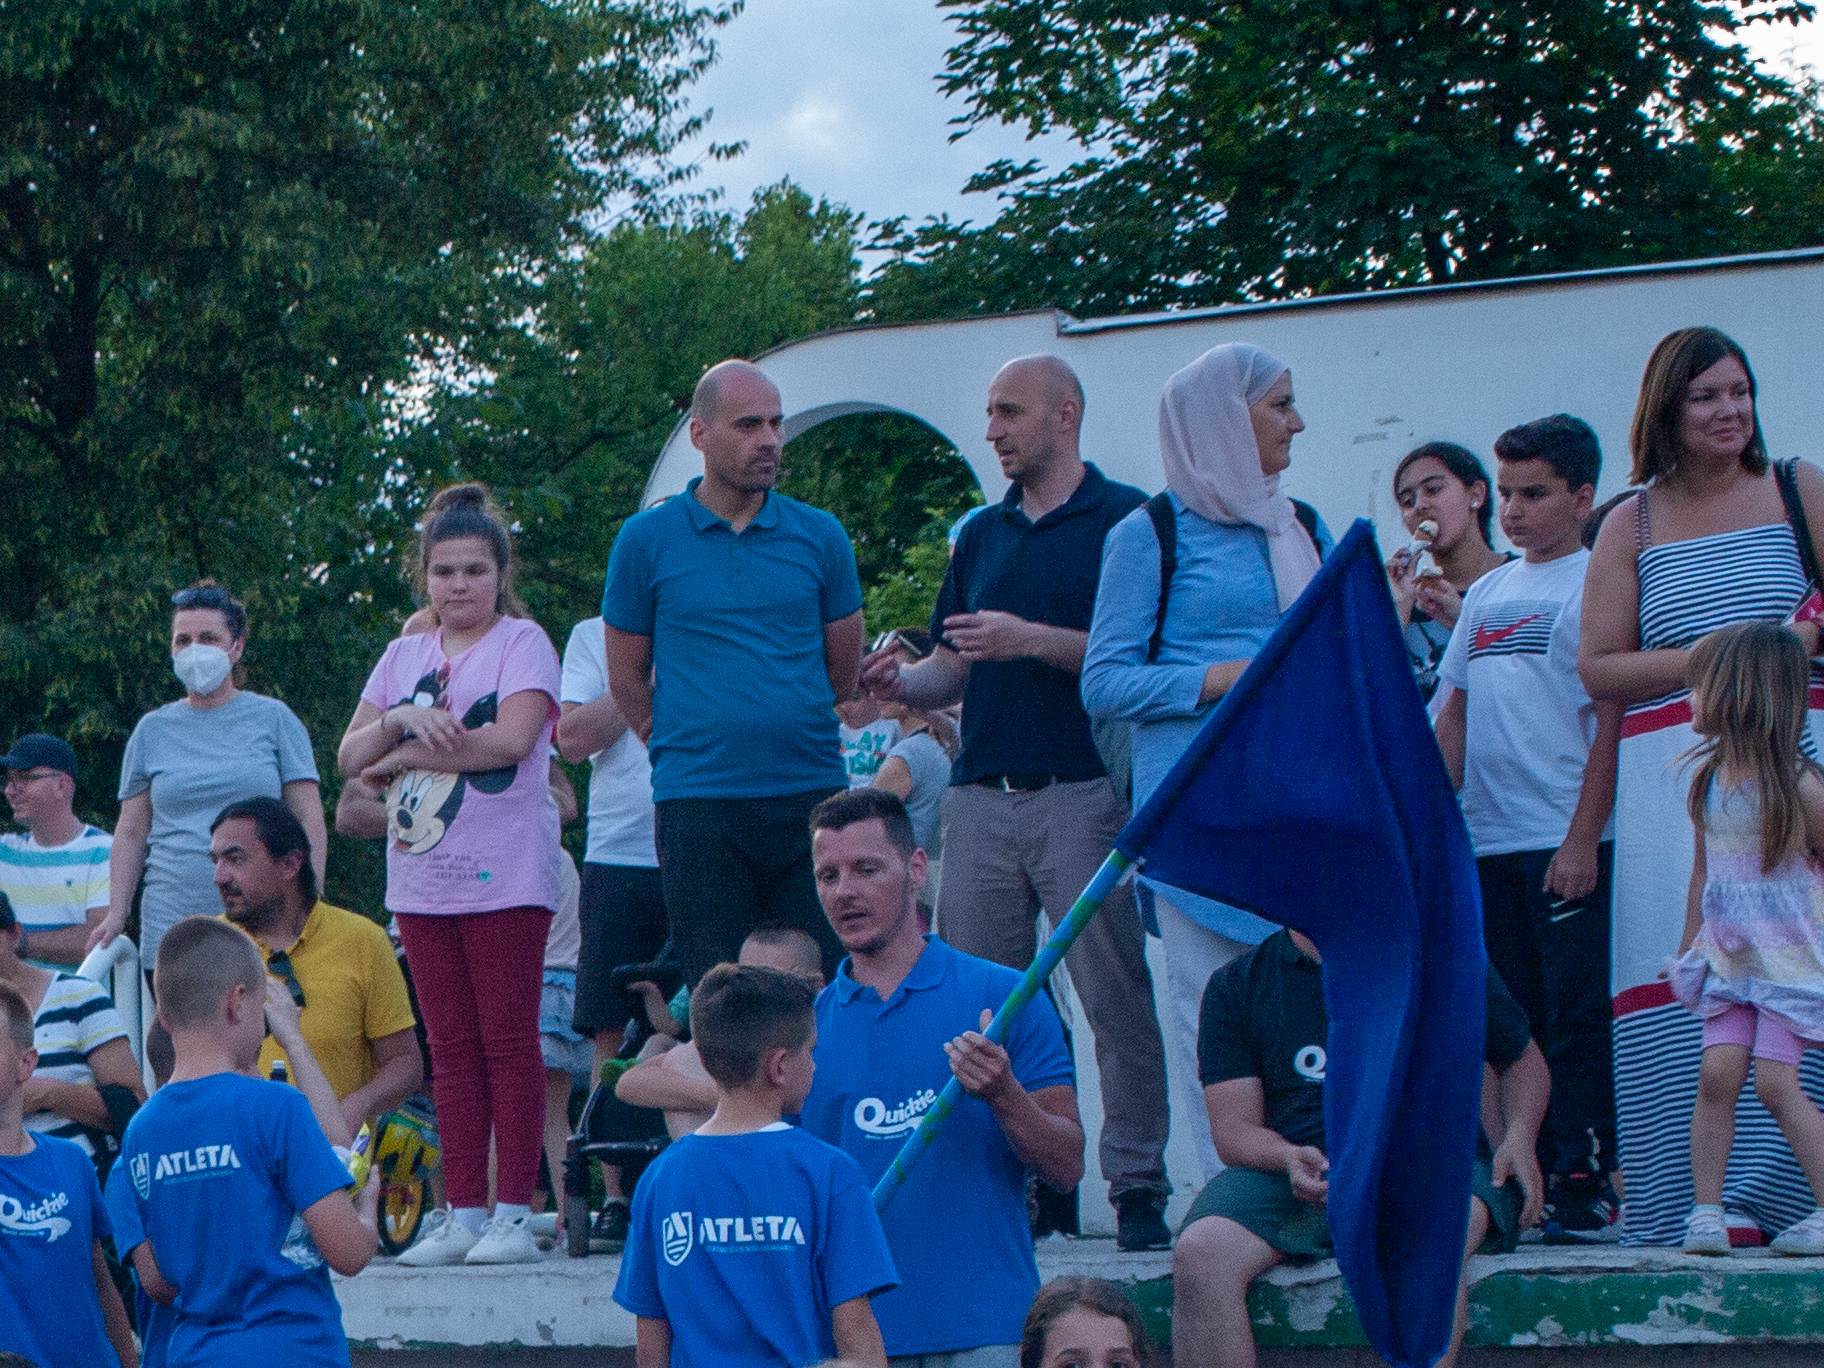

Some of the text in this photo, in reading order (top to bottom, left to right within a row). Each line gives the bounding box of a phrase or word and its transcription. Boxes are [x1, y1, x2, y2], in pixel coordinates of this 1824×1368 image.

[854, 1088, 937, 1134] Quickie
[155, 1144, 242, 1181] ATLETA
[699, 1215, 806, 1246] ATLETA
